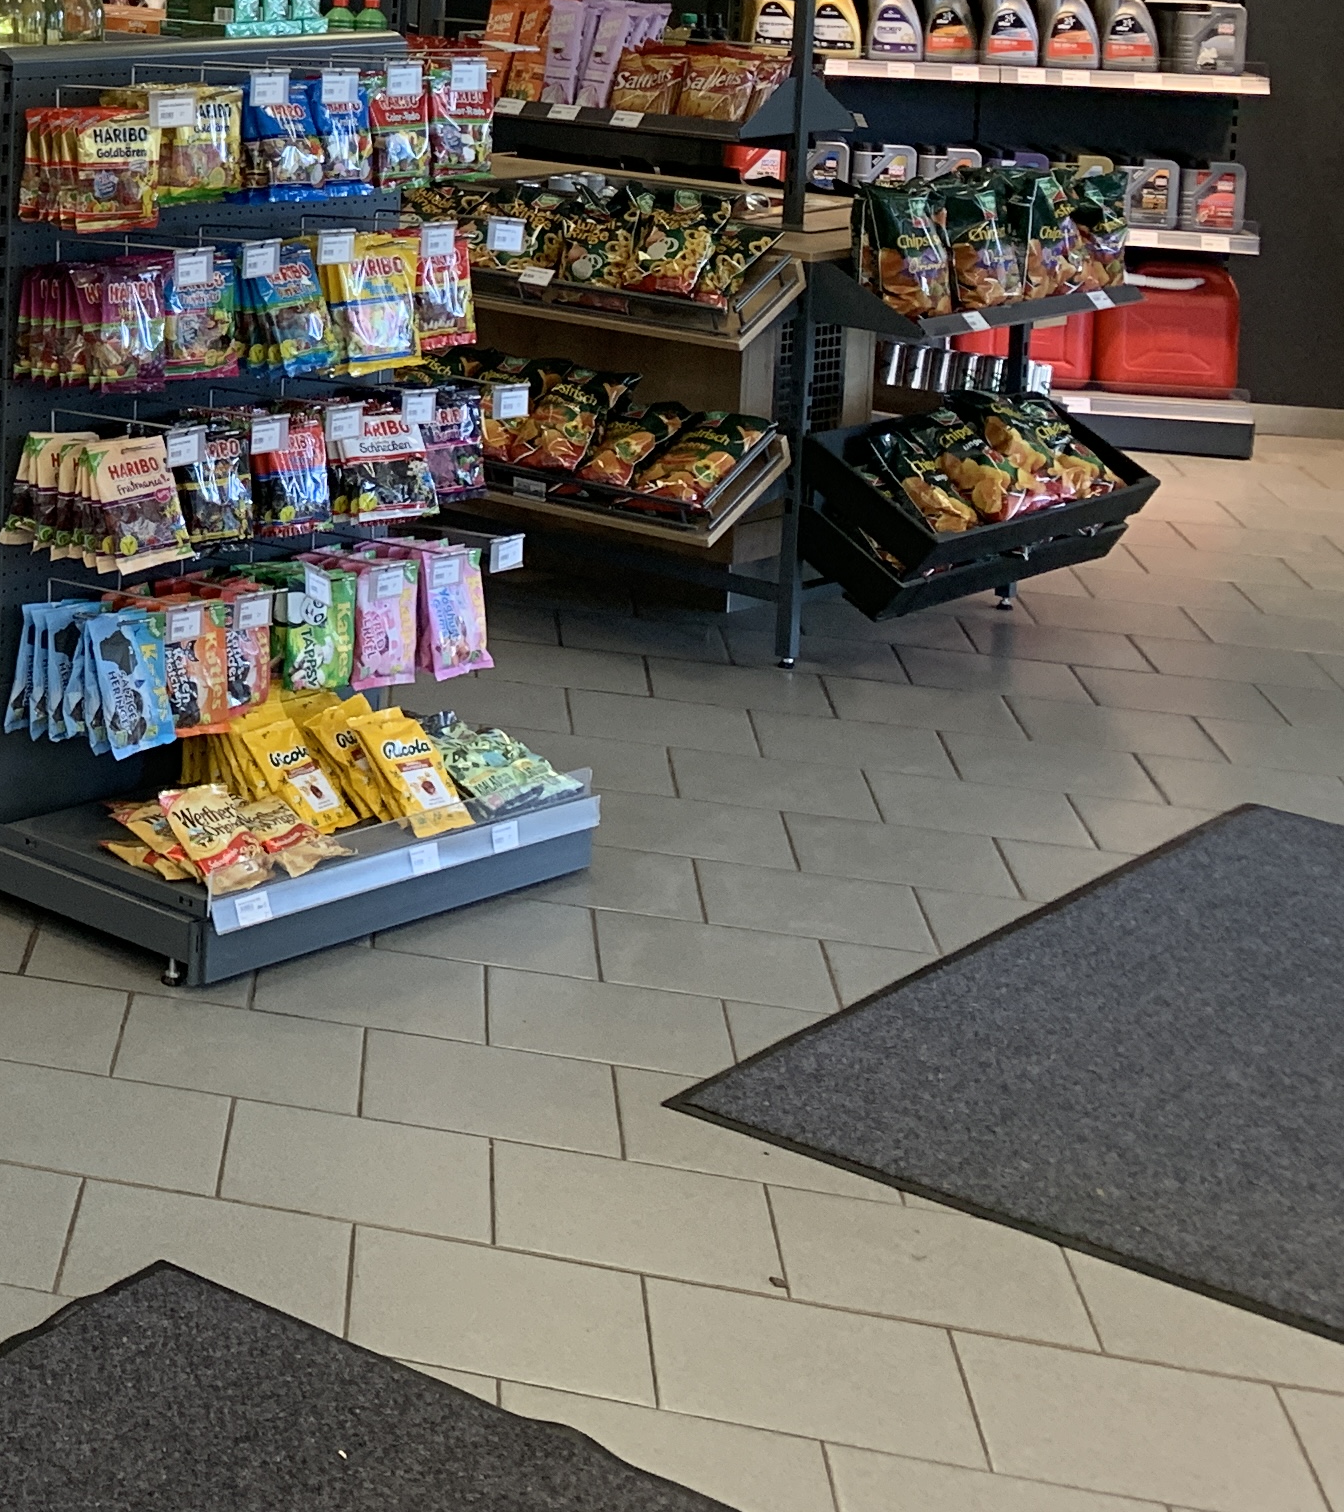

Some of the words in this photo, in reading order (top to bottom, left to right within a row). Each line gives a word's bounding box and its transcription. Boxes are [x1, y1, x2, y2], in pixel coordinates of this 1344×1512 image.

[196, 102, 232, 121] ARIBO
[93, 126, 148, 144] HARIBO
[96, 144, 148, 160] Goldbären
[350, 256, 405, 278] HARIBO
[364, 419, 411, 437] ARIBO
[206, 438, 241, 459] RIBO
[359, 440, 412, 455] Schnecken
[108, 456, 160, 481] HARIBO
[336, 602, 349, 678] Katjes
[301, 629, 320, 687] TAPPSY
[172, 647, 192, 705] Katzen
[382, 739, 432, 760] Ricola
[172, 801, 236, 829] Werther's
